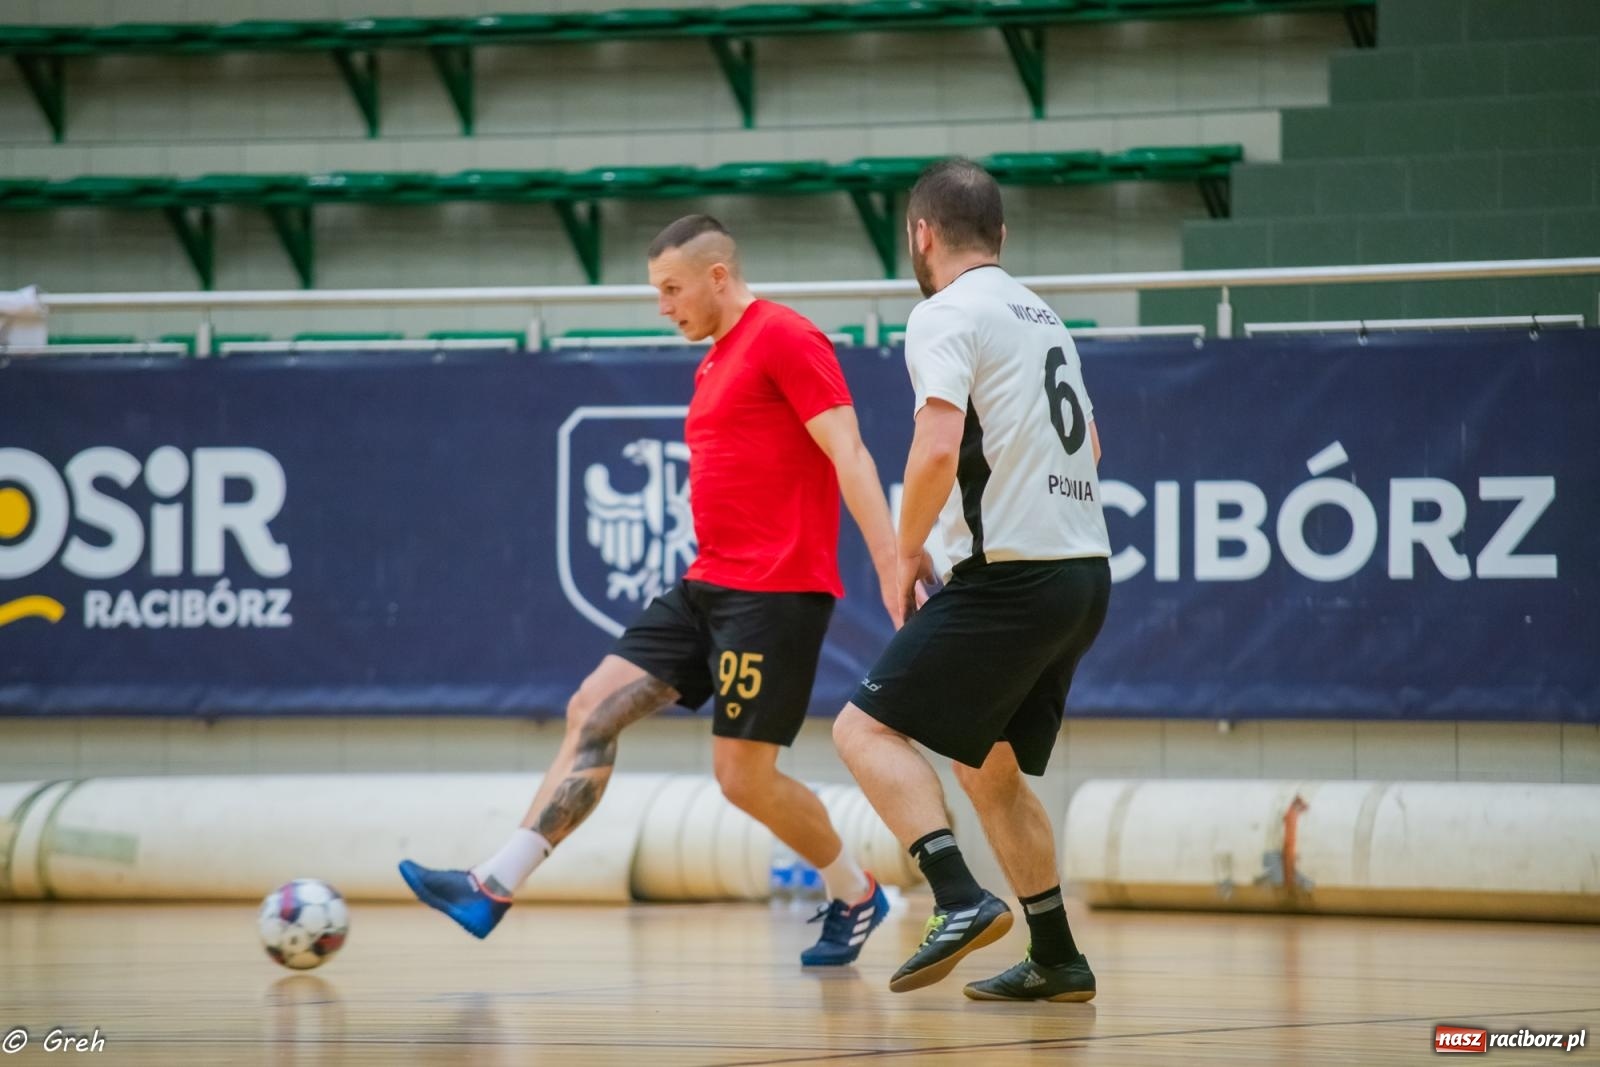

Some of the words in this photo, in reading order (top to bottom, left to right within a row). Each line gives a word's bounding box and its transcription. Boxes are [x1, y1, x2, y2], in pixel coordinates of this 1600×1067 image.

[1044, 346, 1086, 455] 6
[1048, 474, 1094, 501] PŁONIA
[84, 578, 292, 628] RACIBÓRZ
[719, 650, 764, 699] 95
